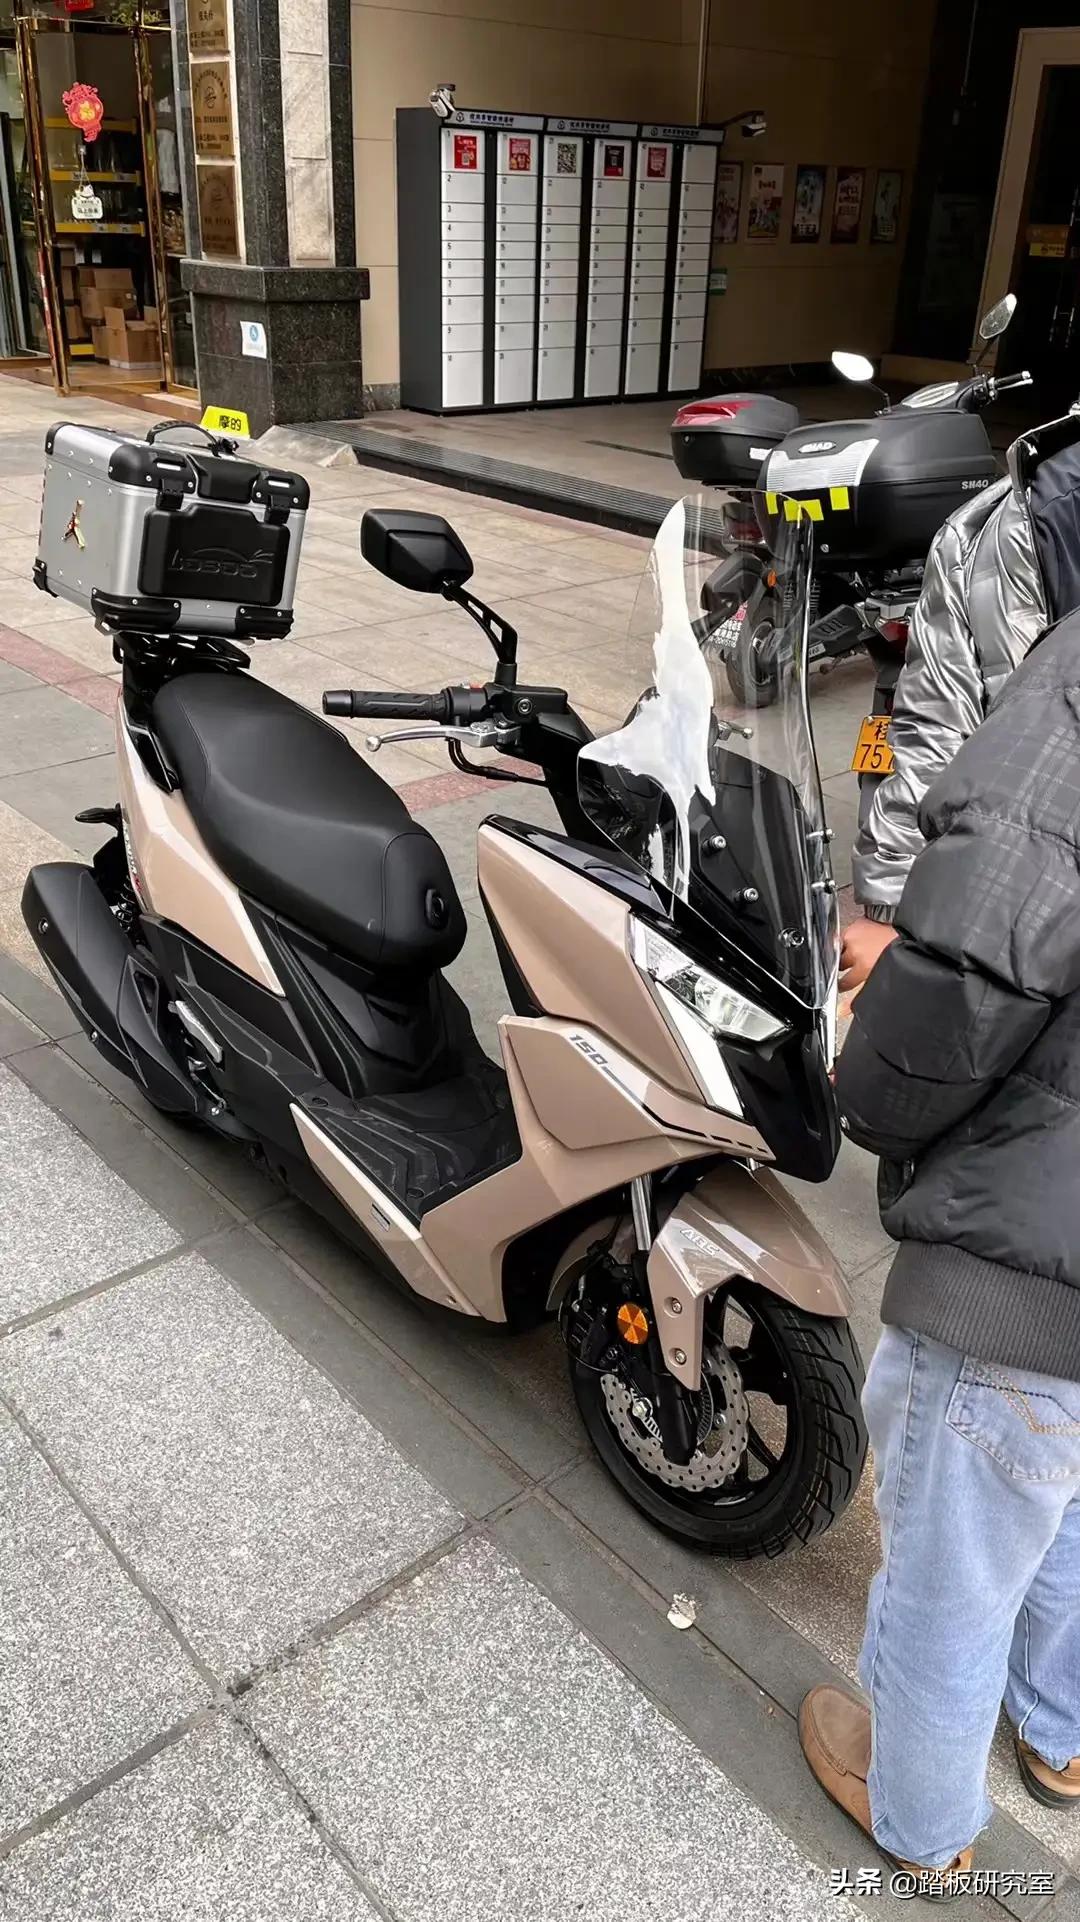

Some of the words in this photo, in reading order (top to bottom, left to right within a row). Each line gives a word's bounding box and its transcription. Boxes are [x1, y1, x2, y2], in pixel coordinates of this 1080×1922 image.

[961, 479, 989, 490] SH40
[569, 1034, 608, 1065] 150
[679, 1228, 720, 1257] ABS
